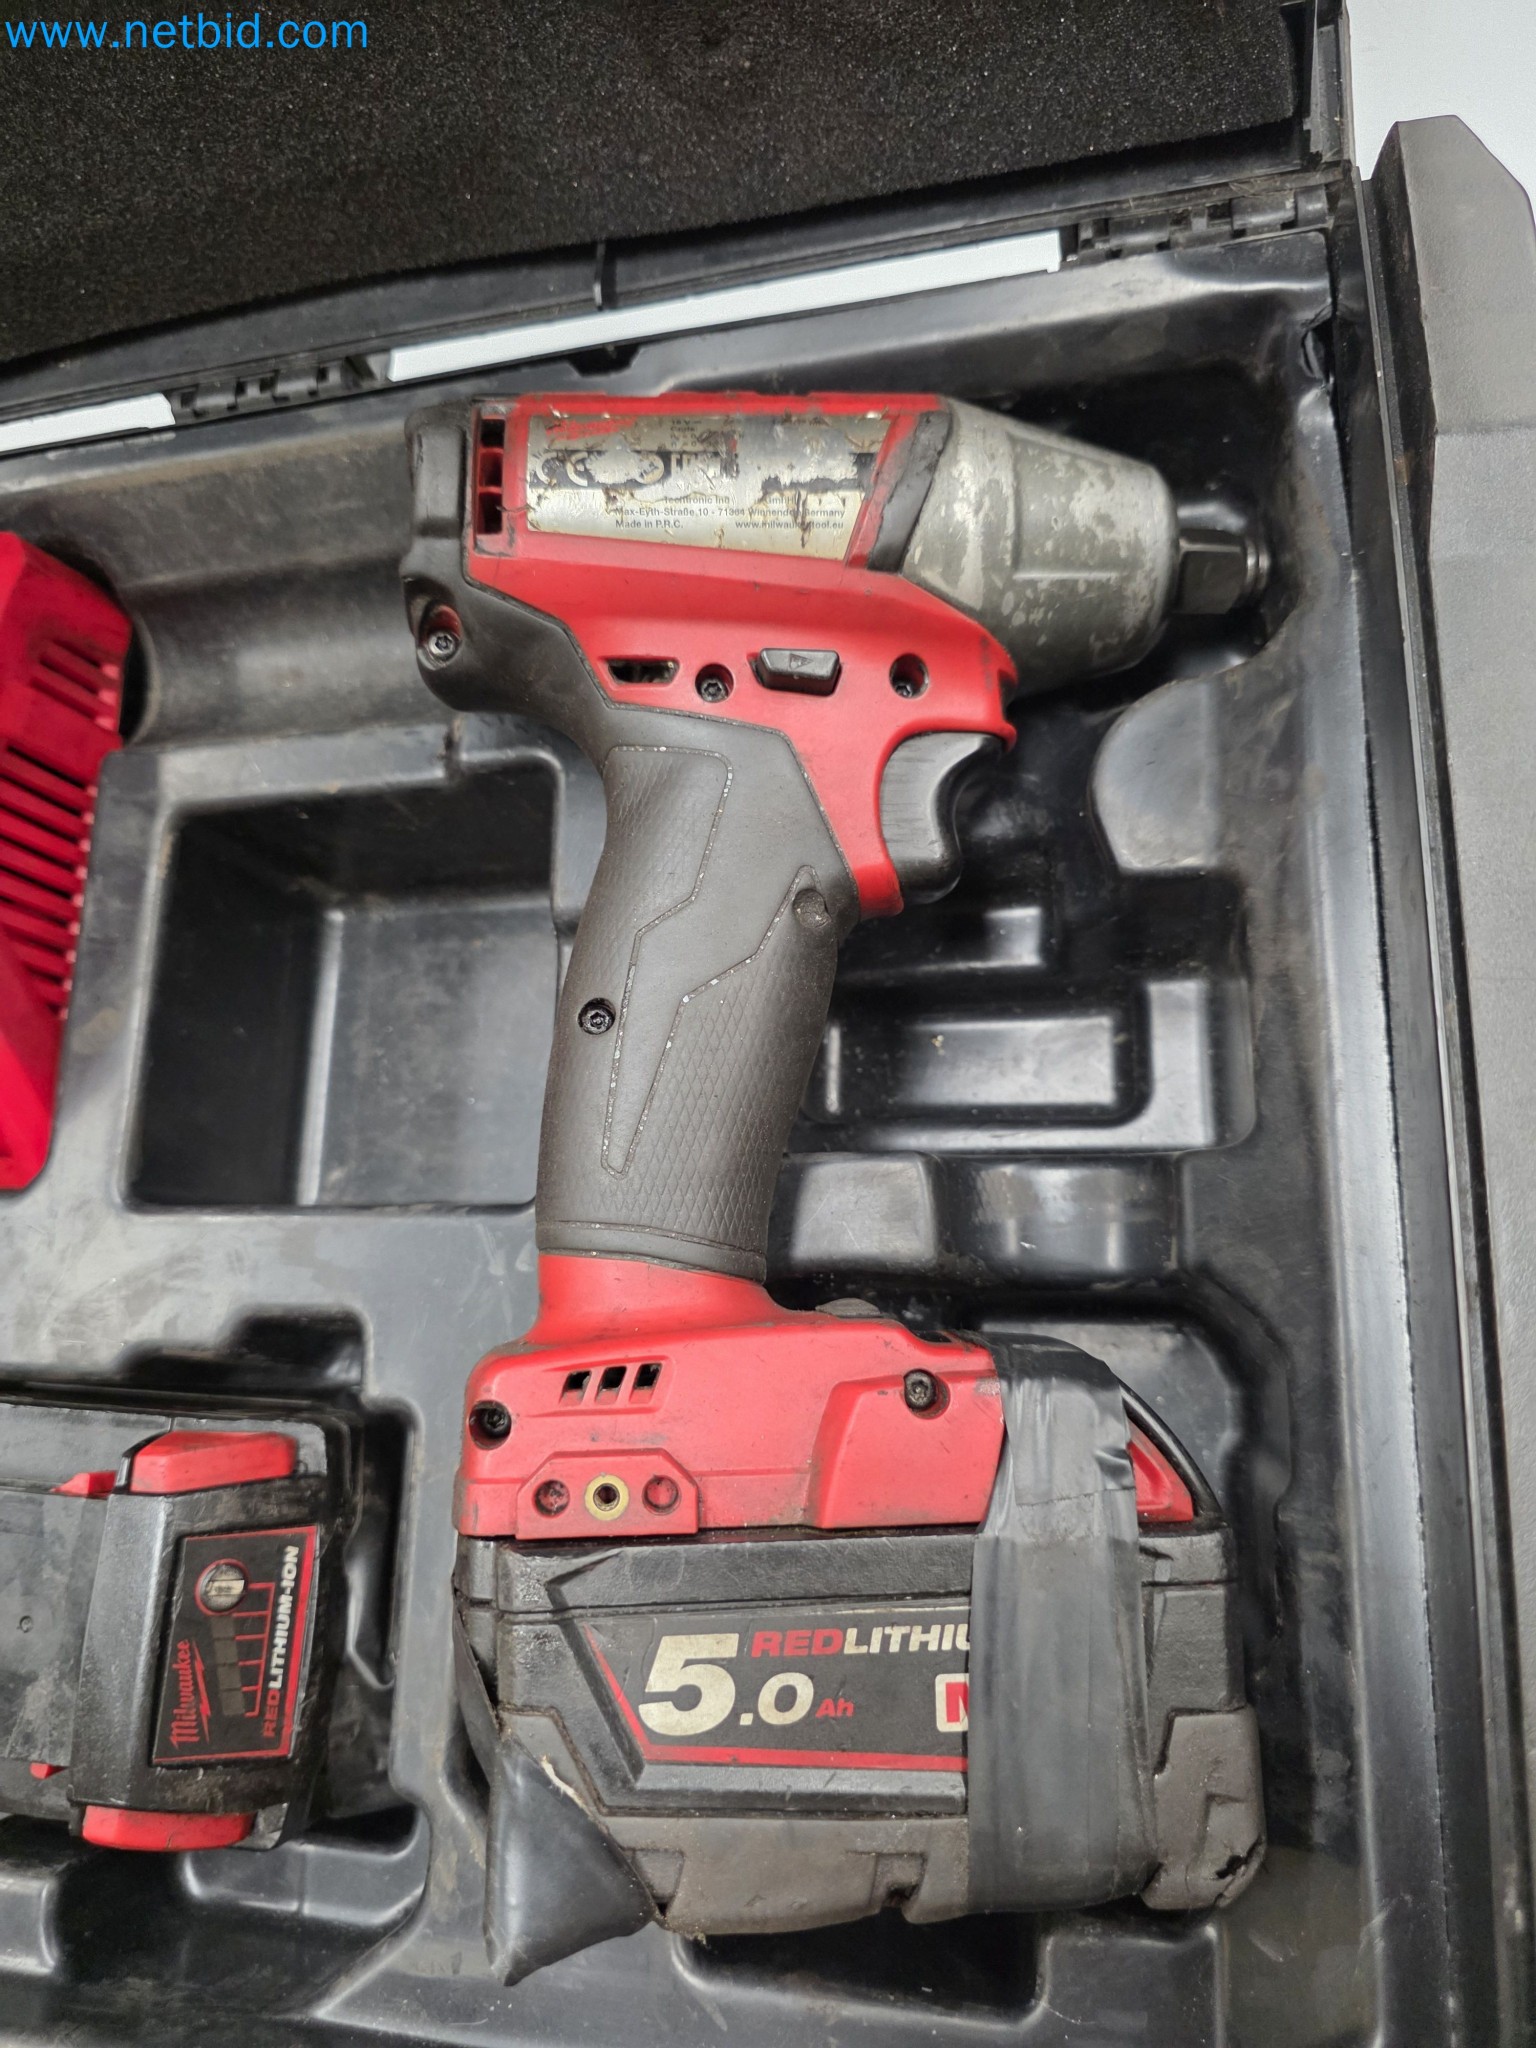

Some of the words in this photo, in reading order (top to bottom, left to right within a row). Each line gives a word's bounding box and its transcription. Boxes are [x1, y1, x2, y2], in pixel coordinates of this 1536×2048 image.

[615, 519, 642, 529] Made
[644, 520, 653, 529] in
[655, 519, 684, 529] P.R.C.
[735, 521, 844, 530] www.milwauktool.eu
[698, 508, 709, 517] 10
[169, 1639, 197, 1751] Milwaukee
[262, 1545, 300, 1740] REDLITHIUM-ION
[638, 1632, 815, 1737] 5.0
[816, 1697, 854, 1719] Ah
